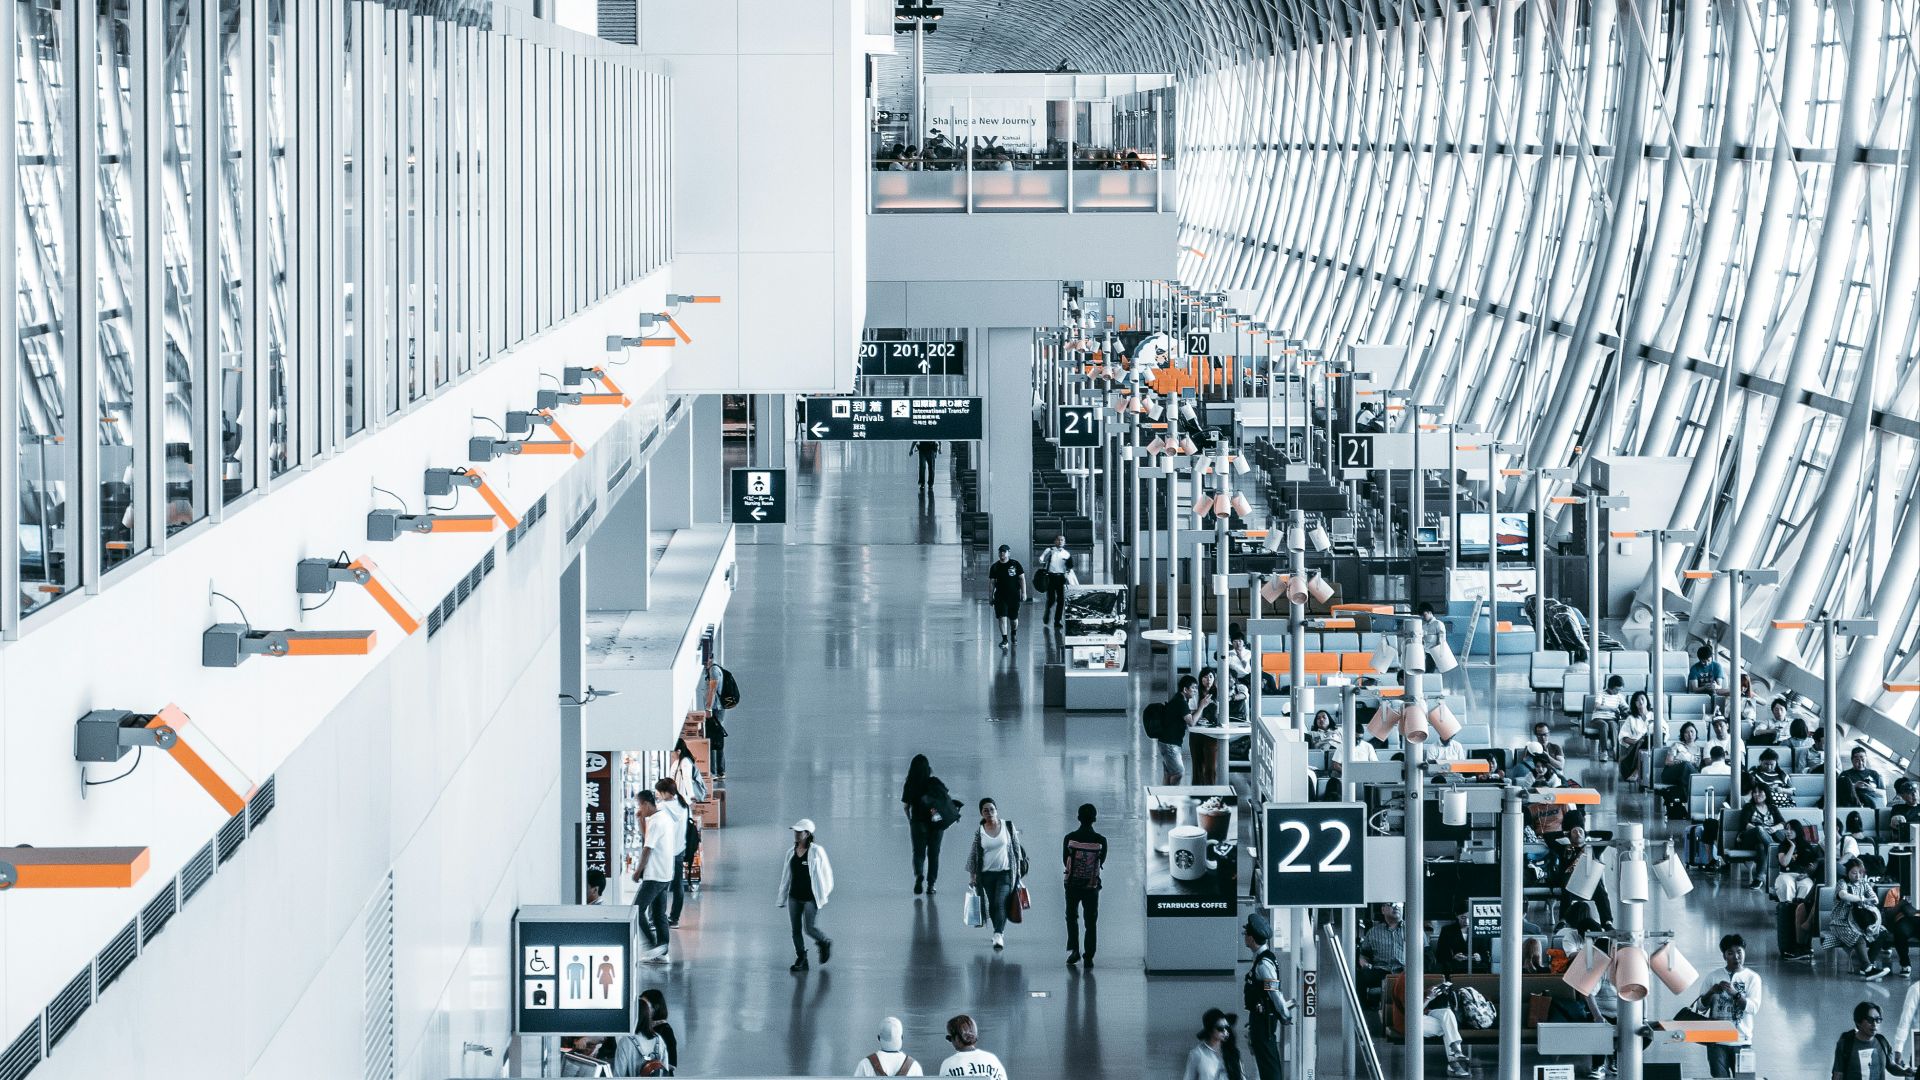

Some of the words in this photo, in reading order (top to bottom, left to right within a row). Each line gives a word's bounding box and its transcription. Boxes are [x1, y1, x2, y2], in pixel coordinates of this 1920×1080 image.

[932, 117, 968, 127] Shaing
[979, 117, 999, 125] New
[1110, 284, 1122, 297] 19
[892, 343, 925, 359] 201,
[928, 343, 956, 357] 202
[1190, 335, 1207, 354] 20
[853, 413, 885, 422] Arrivals
[1064, 411, 1093, 434] 21
[1347, 438, 1368, 466] 21
[1278, 820, 1353, 873] 22
[1305, 986, 1315, 1016] AED
